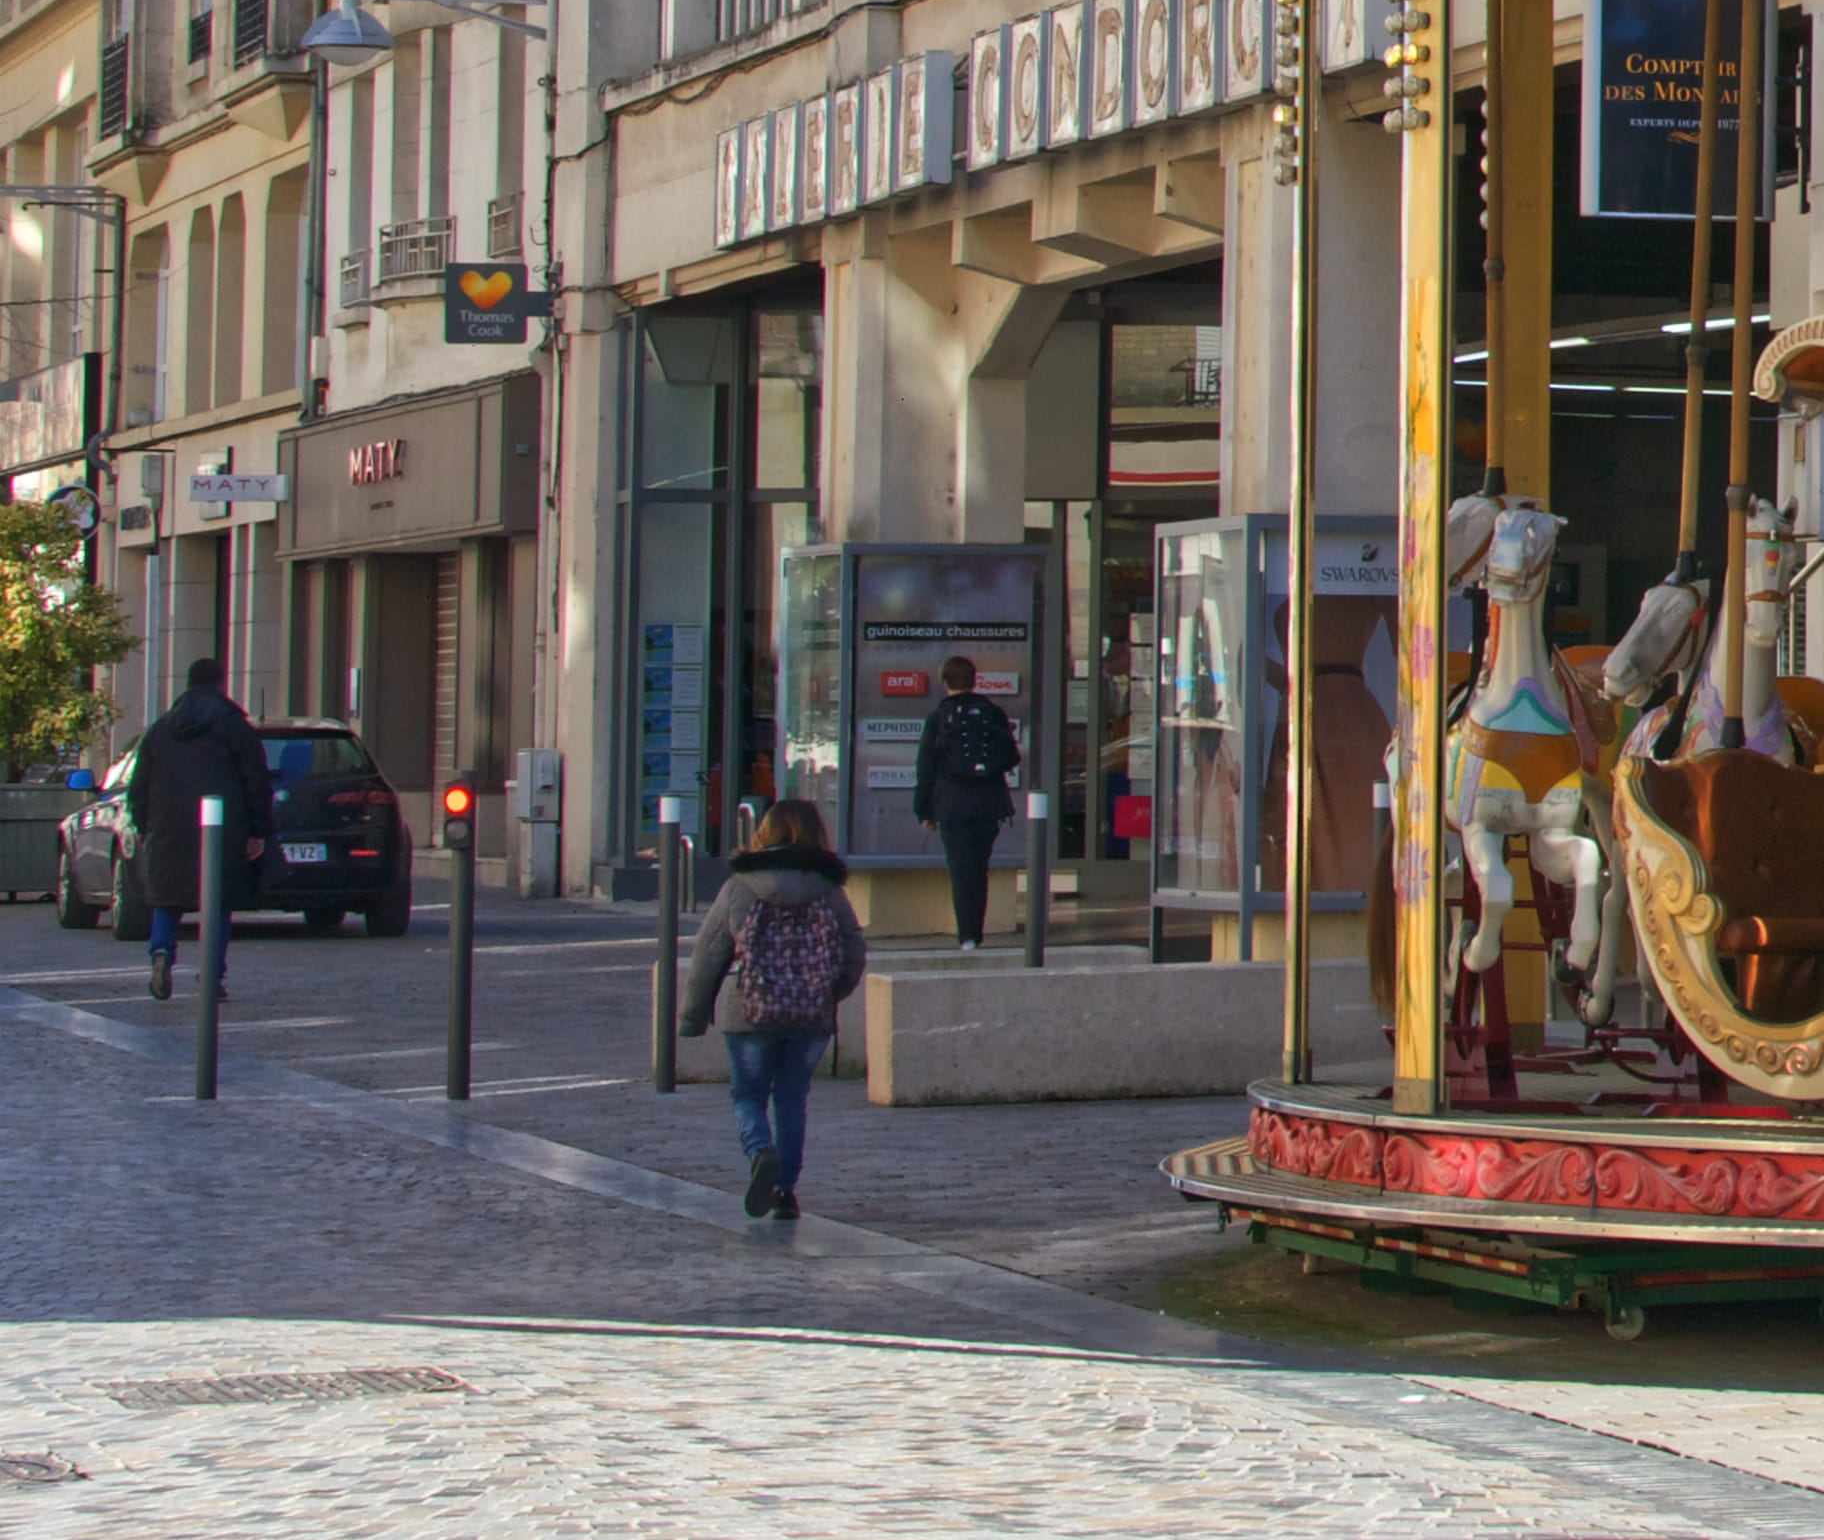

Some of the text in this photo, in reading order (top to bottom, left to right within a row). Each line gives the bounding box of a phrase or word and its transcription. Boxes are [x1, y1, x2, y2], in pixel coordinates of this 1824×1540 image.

[1625, 53, 1737, 76] COMPTIR
[1717, 119, 1740, 130] 1977
[459, 310, 514, 323] Thomas
[468, 324, 503, 336] Cook
[348, 439, 401, 485] MATY
[193, 479, 270, 491] MATY
[1321, 566, 1399, 582] SWAROVS
[867, 624, 1025, 639] guinoiseau chaussures
[887, 674, 914, 687] ara
[867, 723, 921, 732] MEPHISTO
